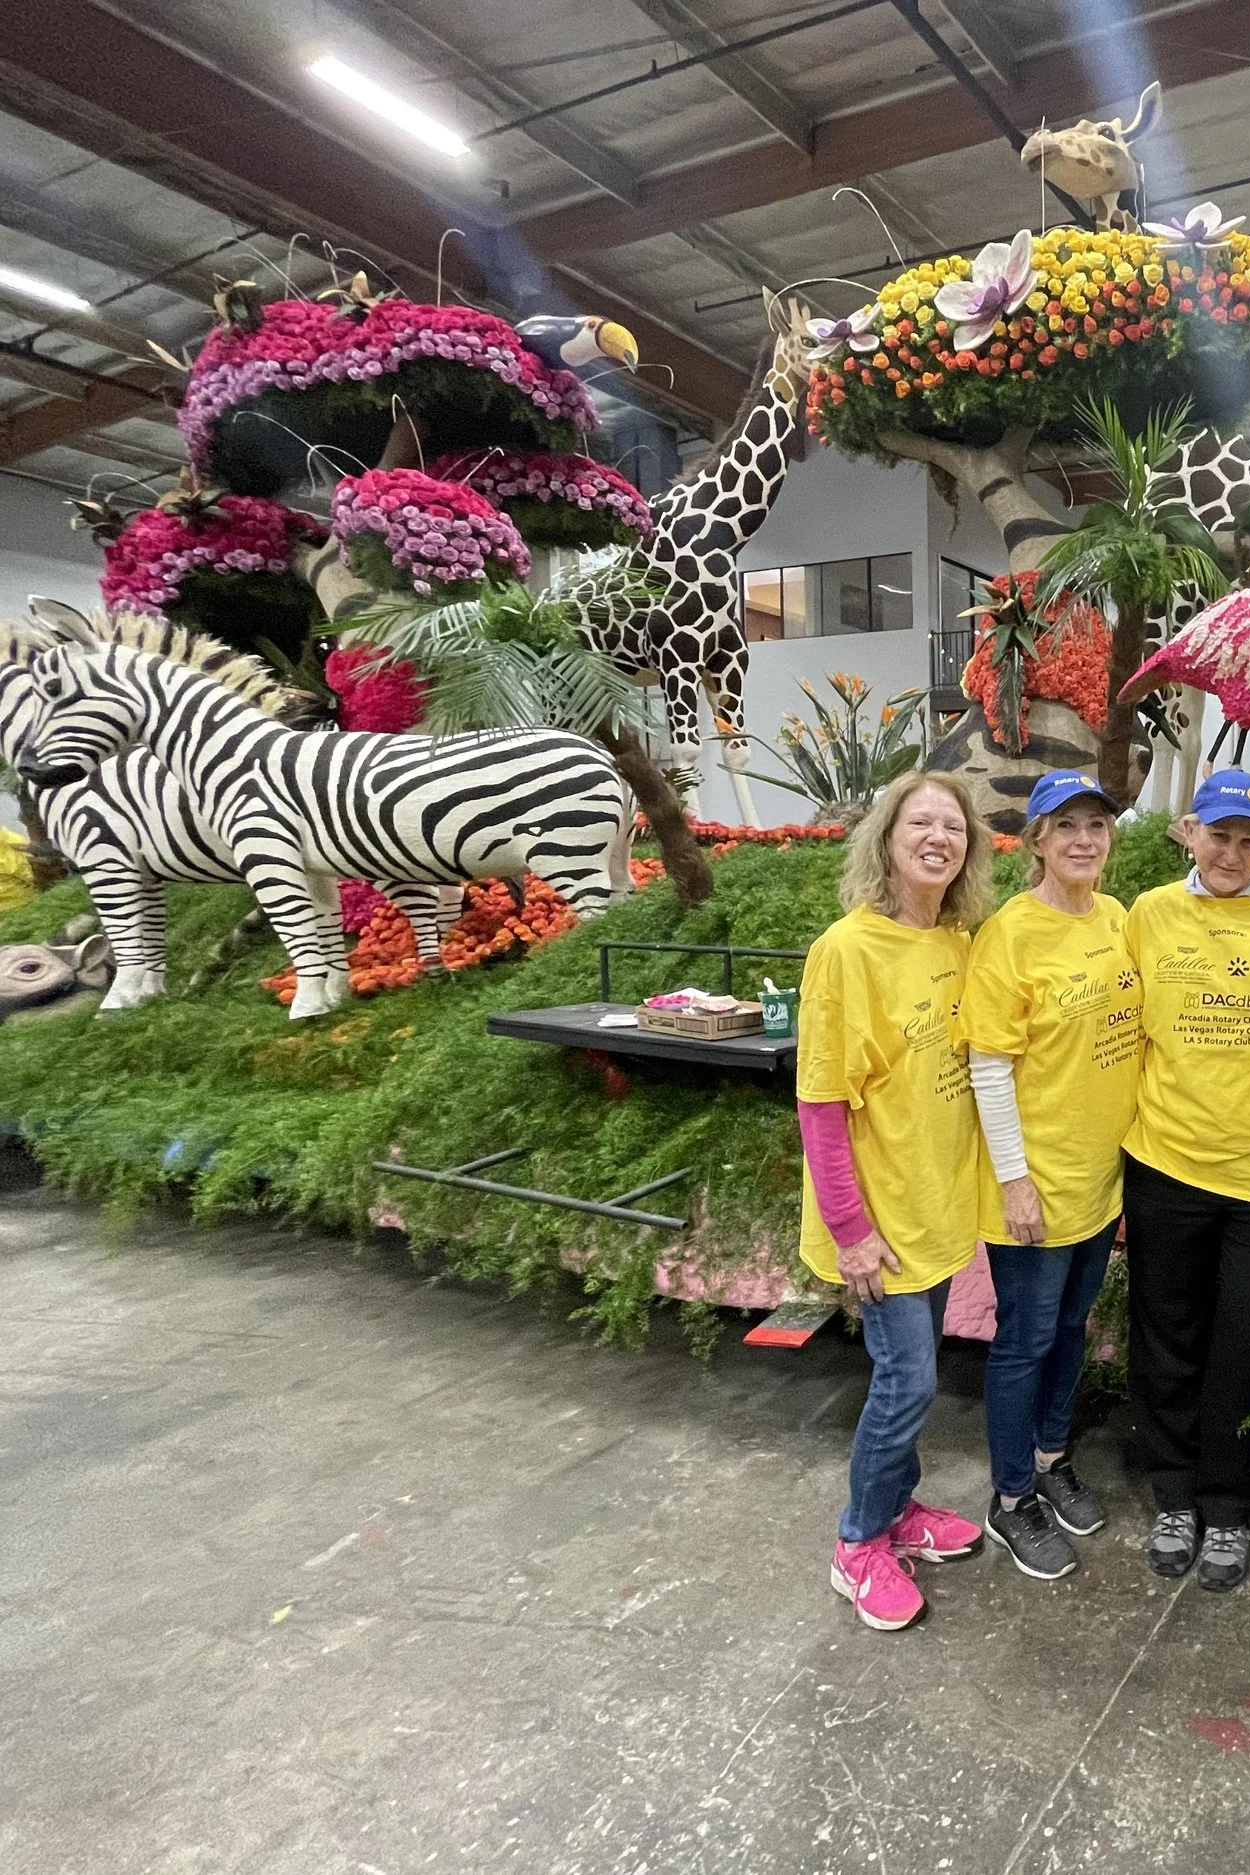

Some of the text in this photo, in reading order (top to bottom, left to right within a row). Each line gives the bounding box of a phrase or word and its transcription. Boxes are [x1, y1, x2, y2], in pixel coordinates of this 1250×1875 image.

[1054, 777, 1080, 787] Rotary
[1220, 786, 1246, 796] Rotary
[1207, 928, 1247, 938] Sponsors:
[1156, 953, 1216, 971] Cadillac
[1059, 979, 1109, 1008] Cadillac
[1178, 1013, 1211, 1023] Arcadia
[1212, 1015, 1242, 1025] Rotary
[1173, 1025, 1187, 1033] Las
[1189, 1025, 1215, 1036] Vegas
[1216, 1027, 1245, 1037] Rotary
[1184, 1036, 1195, 1044] LA
[1204, 1037, 1233, 1047] Rotary
[1092, 1053, 1103, 1062] Las
[1101, 1060, 1110, 1070] LA
[935, 1085, 948, 1094] Las
[946, 1093, 955, 1102] LA
